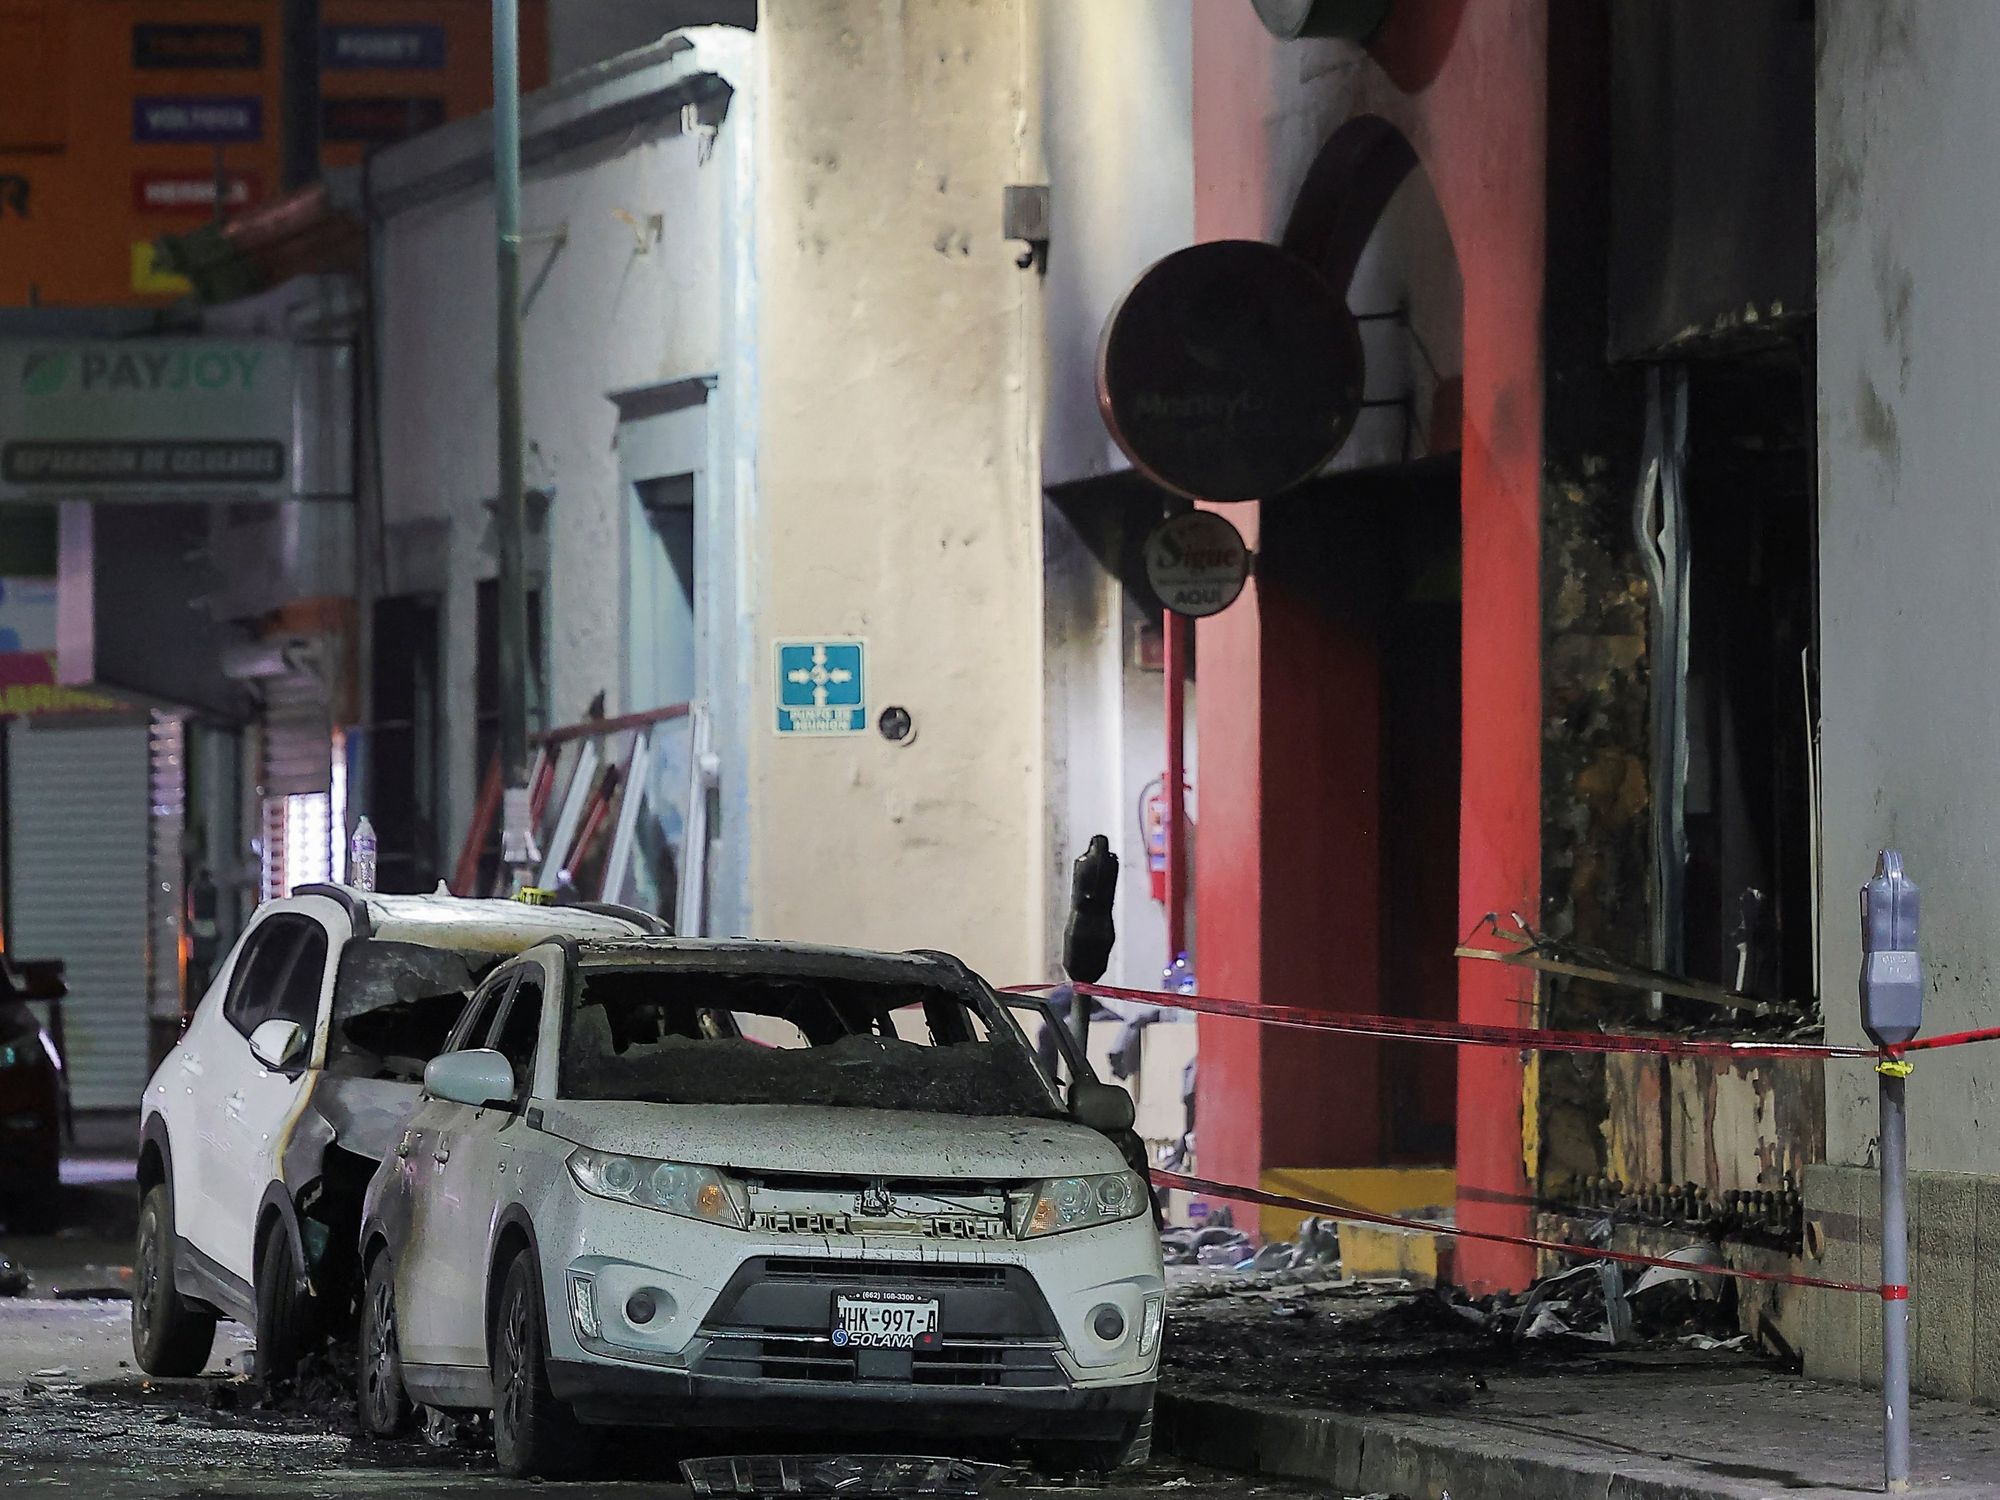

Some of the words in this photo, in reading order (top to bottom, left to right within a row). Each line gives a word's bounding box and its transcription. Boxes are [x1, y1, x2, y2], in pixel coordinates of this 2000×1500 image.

[81, 349, 264, 391] PAYJOY
[862, 1291, 881, 1300] (662)
[848, 1332, 914, 1348] SOLANA
